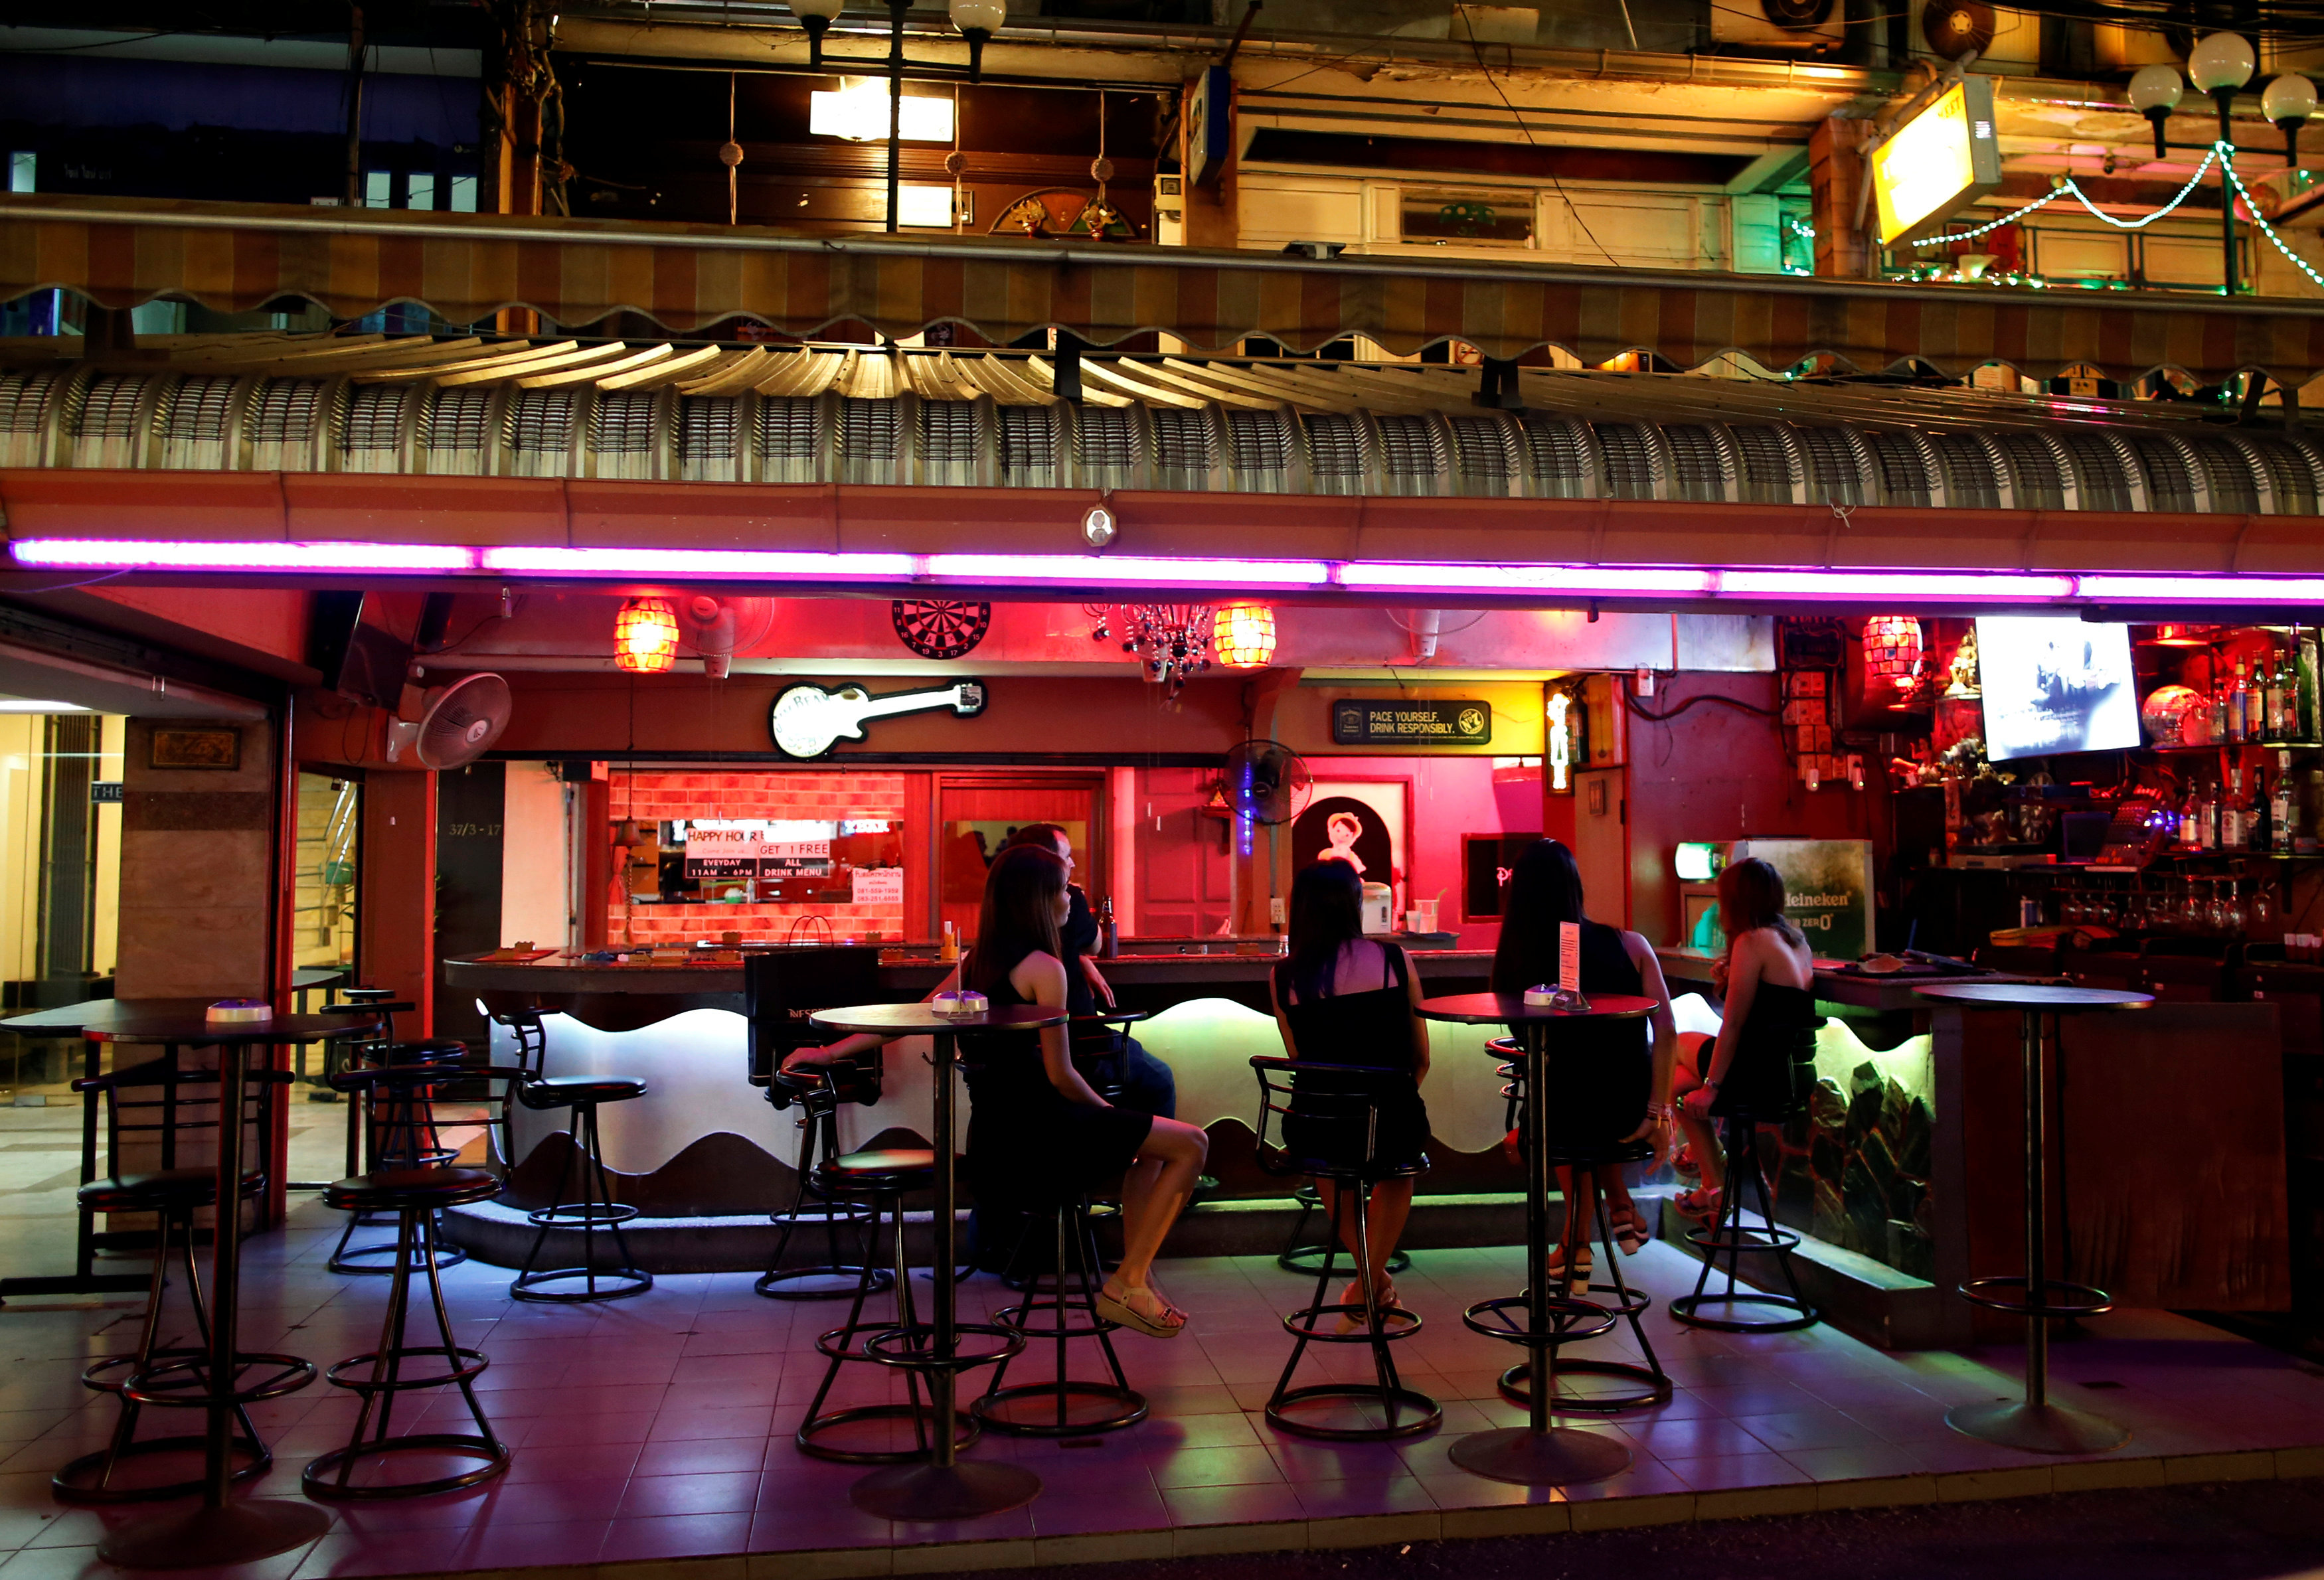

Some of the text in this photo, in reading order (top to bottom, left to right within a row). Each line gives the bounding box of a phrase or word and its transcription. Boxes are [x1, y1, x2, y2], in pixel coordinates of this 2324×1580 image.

[1370, 712, 1392, 722] PACE
[1395, 712, 1440, 722] YOURSELF.
[1370, 723, 1455, 734] DRINK RESPONSIBLY.
[92, 786, 123, 797] THE
[449, 823, 477, 836] 37/3
[488, 824, 501, 836] 17
[688, 831, 722, 842] HAPPY
[726, 831, 757, 842] HOUR
[760, 844, 828, 854] GET 1 FREE
